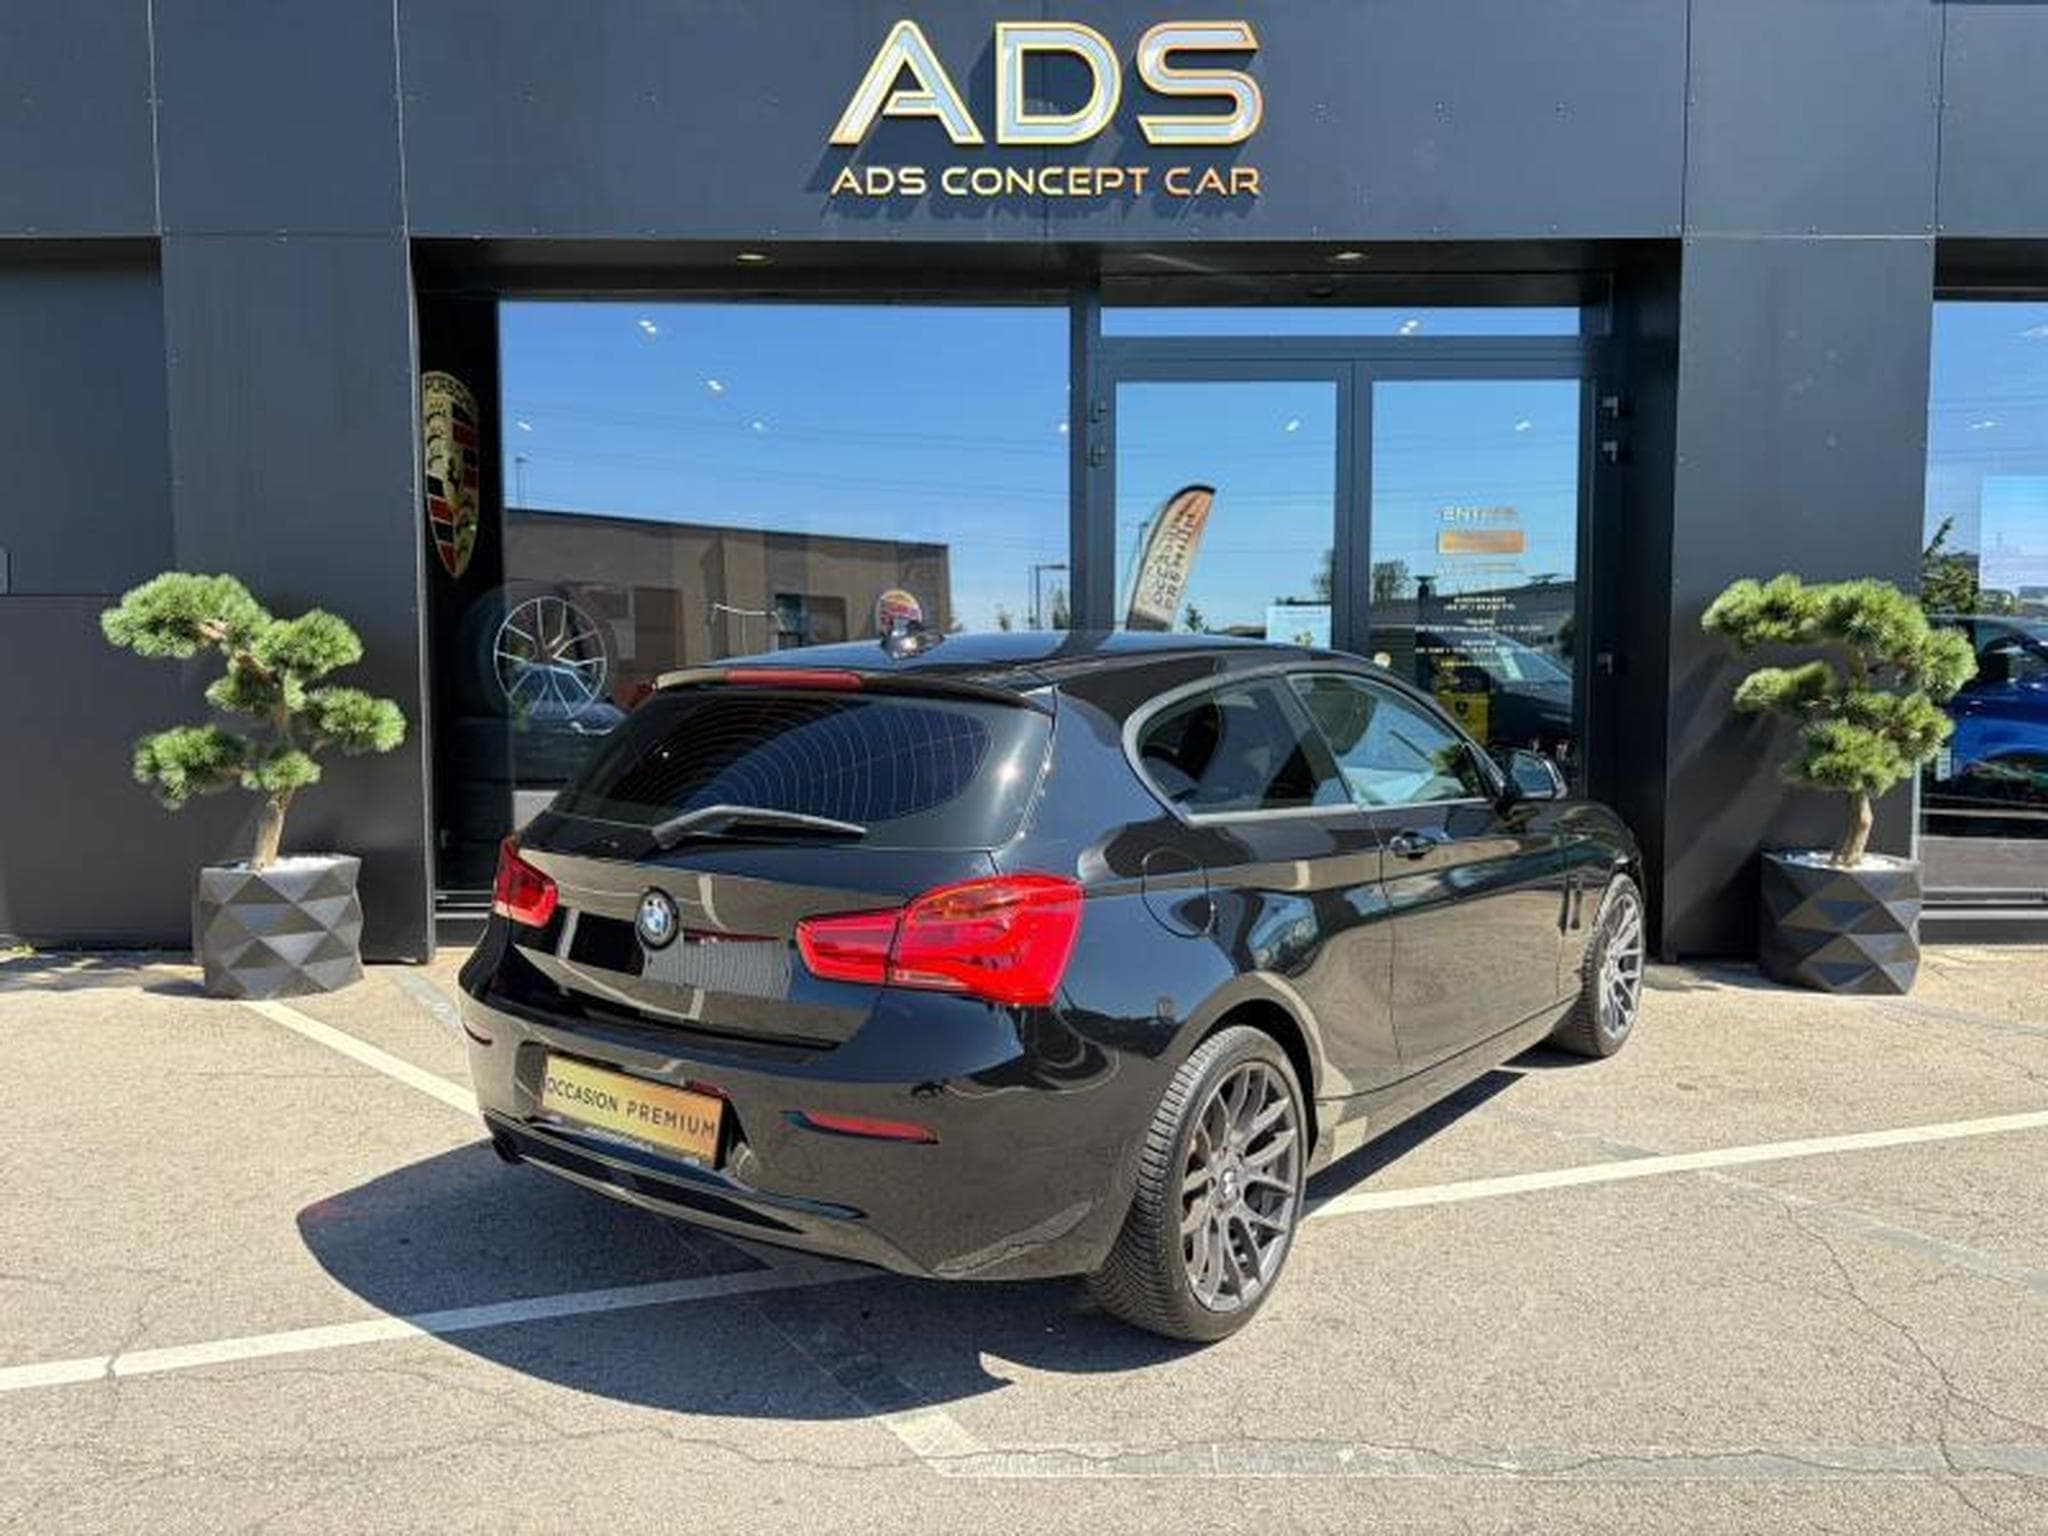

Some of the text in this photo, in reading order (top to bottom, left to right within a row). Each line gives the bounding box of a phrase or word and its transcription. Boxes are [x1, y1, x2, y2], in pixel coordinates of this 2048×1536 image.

[828, 19, 1264, 146] ADS
[830, 166, 1261, 196] ADS CONCEPT CAR
[546, 1076, 716, 1139] OCCASION PREMIUM
